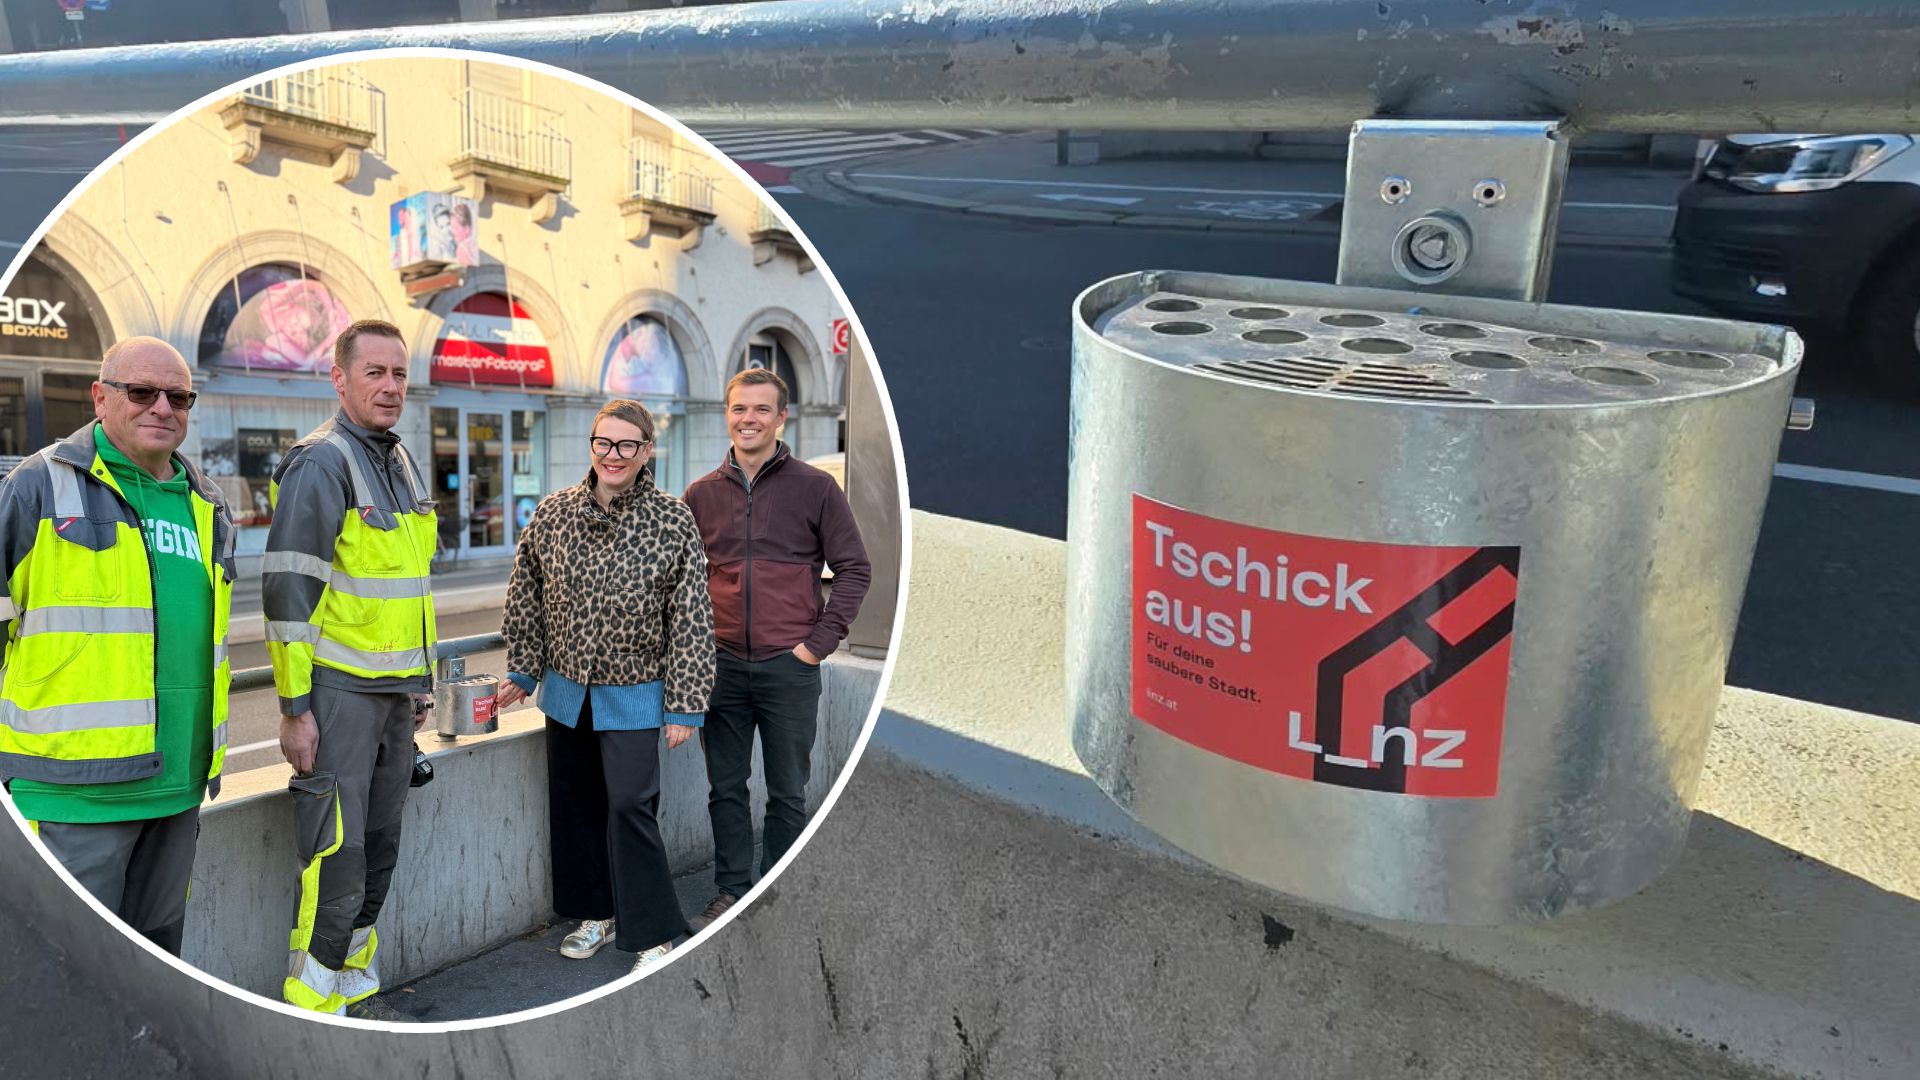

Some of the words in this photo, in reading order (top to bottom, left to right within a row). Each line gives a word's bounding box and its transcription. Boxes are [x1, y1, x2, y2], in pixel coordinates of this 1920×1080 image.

[0, 296, 67, 328] BOX
[2, 324, 68, 339] BOXING
[1146, 520, 1374, 614] Tschick
[1145, 589, 1252, 653] aus!
[1147, 631, 1169, 652] Für
[1173, 644, 1215, 669] deine
[1146, 653, 1204, 685] saubere
[1208, 676, 1262, 704] Stadt.
